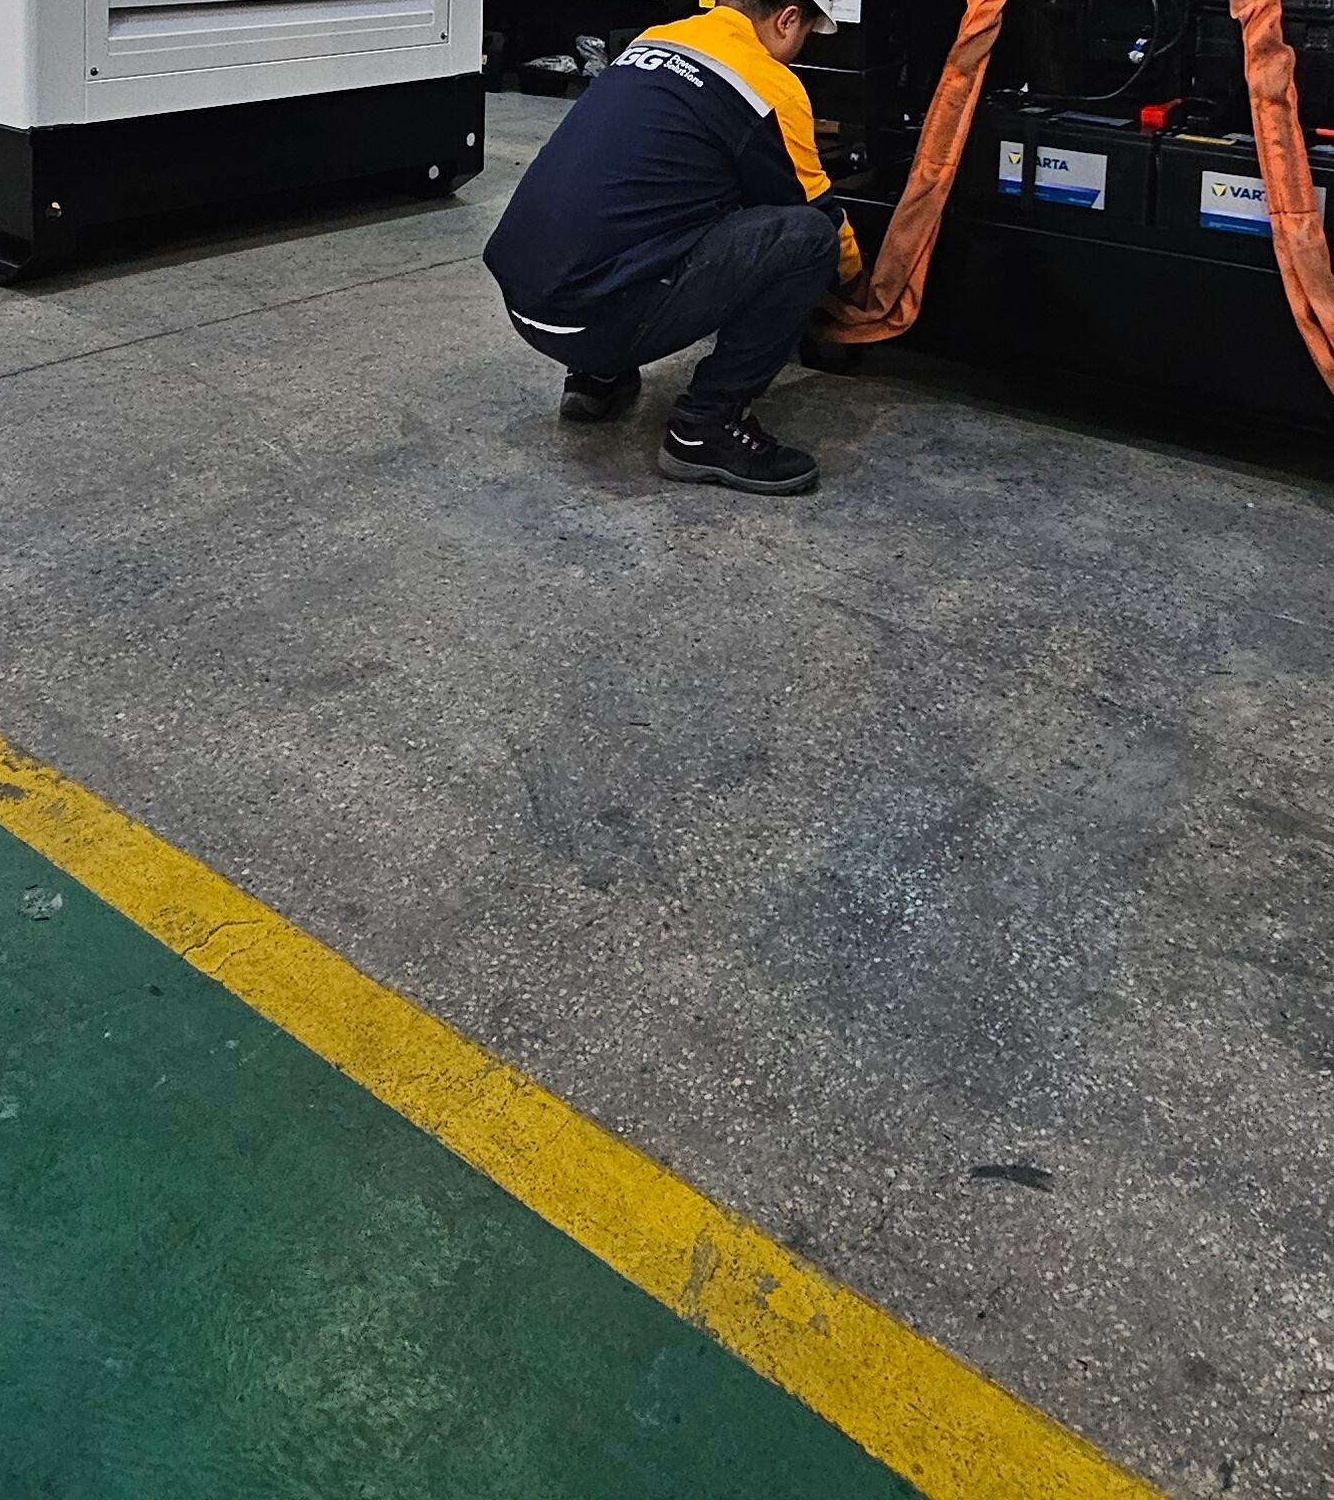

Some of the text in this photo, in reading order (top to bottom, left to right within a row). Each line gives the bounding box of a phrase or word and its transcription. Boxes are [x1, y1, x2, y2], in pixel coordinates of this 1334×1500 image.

[663, 62, 705, 88] Solutions
[1035, 155, 1071, 172] ARTA
[1229, 185, 1267, 202] VAR
